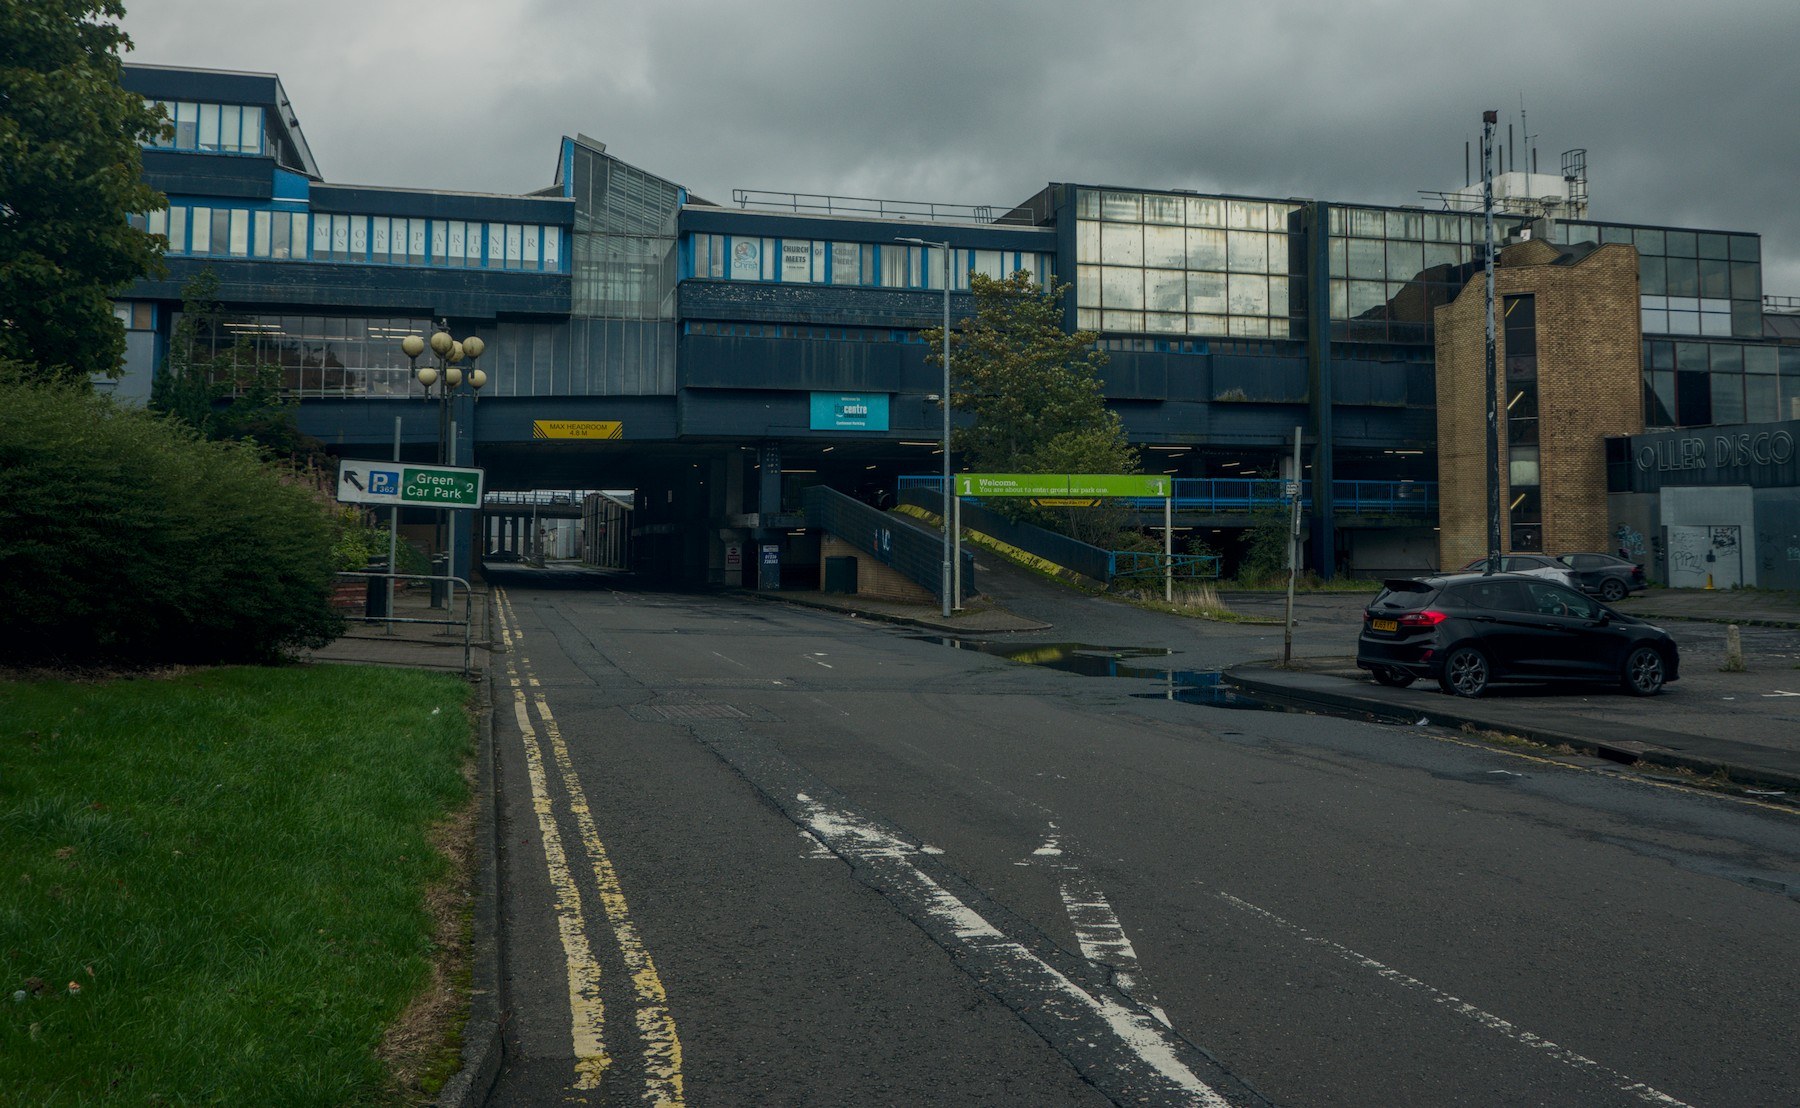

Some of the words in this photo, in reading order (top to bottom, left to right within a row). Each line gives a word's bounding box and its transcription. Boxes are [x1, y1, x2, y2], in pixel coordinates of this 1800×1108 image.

[317, 226, 404, 241] MOORE
[414, 230, 556, 249] PARTNERS
[337, 238, 518, 256] SOLICITORS
[783, 245, 809, 254] CHURCH
[785, 255, 806, 263] MEETS
[566, 423, 608, 431] HEADROOM
[1714, 430, 1795, 468] DISCO
[372, 473, 389, 492] P
[416, 472, 454, 486] Green
[979, 478, 1019, 487] Welcome.
[379, 485, 395, 493] 362
[406, 485, 430, 497] Car
[434, 487, 462, 499] Park
[465, 482, 474, 493] 2
[963, 479, 972, 495] 1
[1080, 486, 1095, 494] park
[1156, 480, 1165, 495] 1
